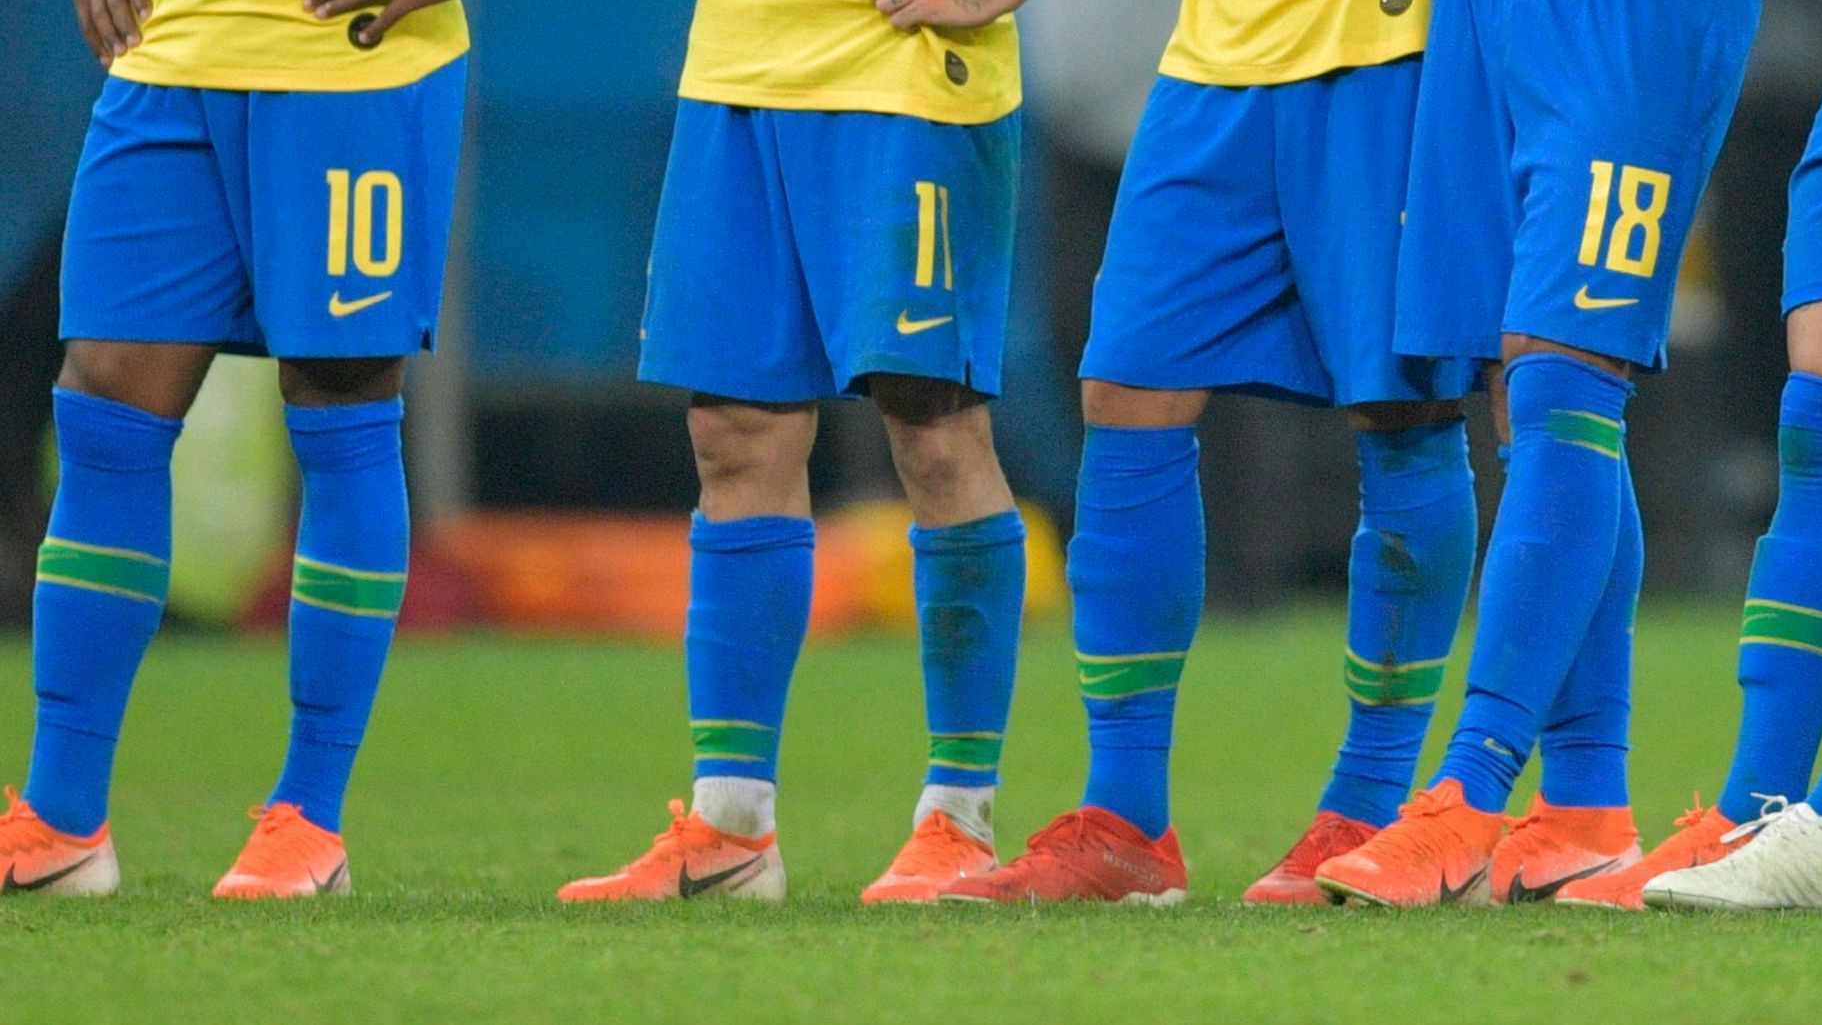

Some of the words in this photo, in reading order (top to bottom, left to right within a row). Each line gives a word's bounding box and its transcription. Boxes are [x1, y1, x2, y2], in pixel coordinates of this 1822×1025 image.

[326, 168, 404, 278] 10
[915, 180, 954, 291] 11
[1576, 159, 1672, 279] 18
